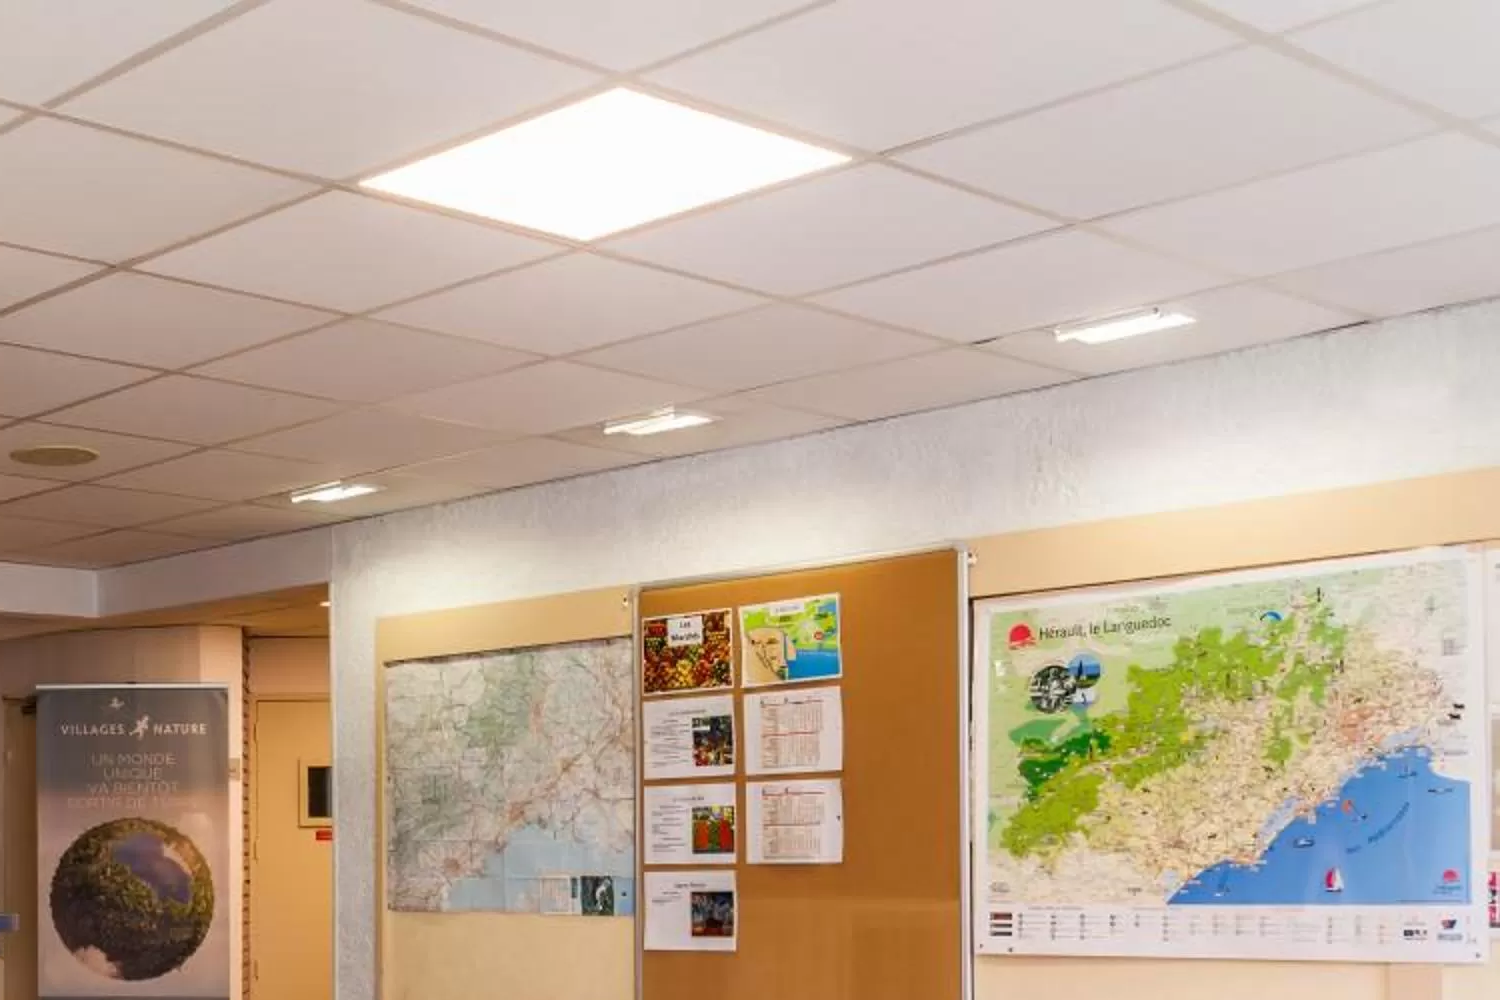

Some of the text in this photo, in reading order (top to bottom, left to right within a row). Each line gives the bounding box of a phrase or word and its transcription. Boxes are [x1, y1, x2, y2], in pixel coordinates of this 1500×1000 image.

[1089, 622, 1100, 635] le
[1103, 615, 1172, 634] Languedoc
[60, 723, 208, 736] VILLAGES NATURE
[117, 752, 177, 765] MONDE
